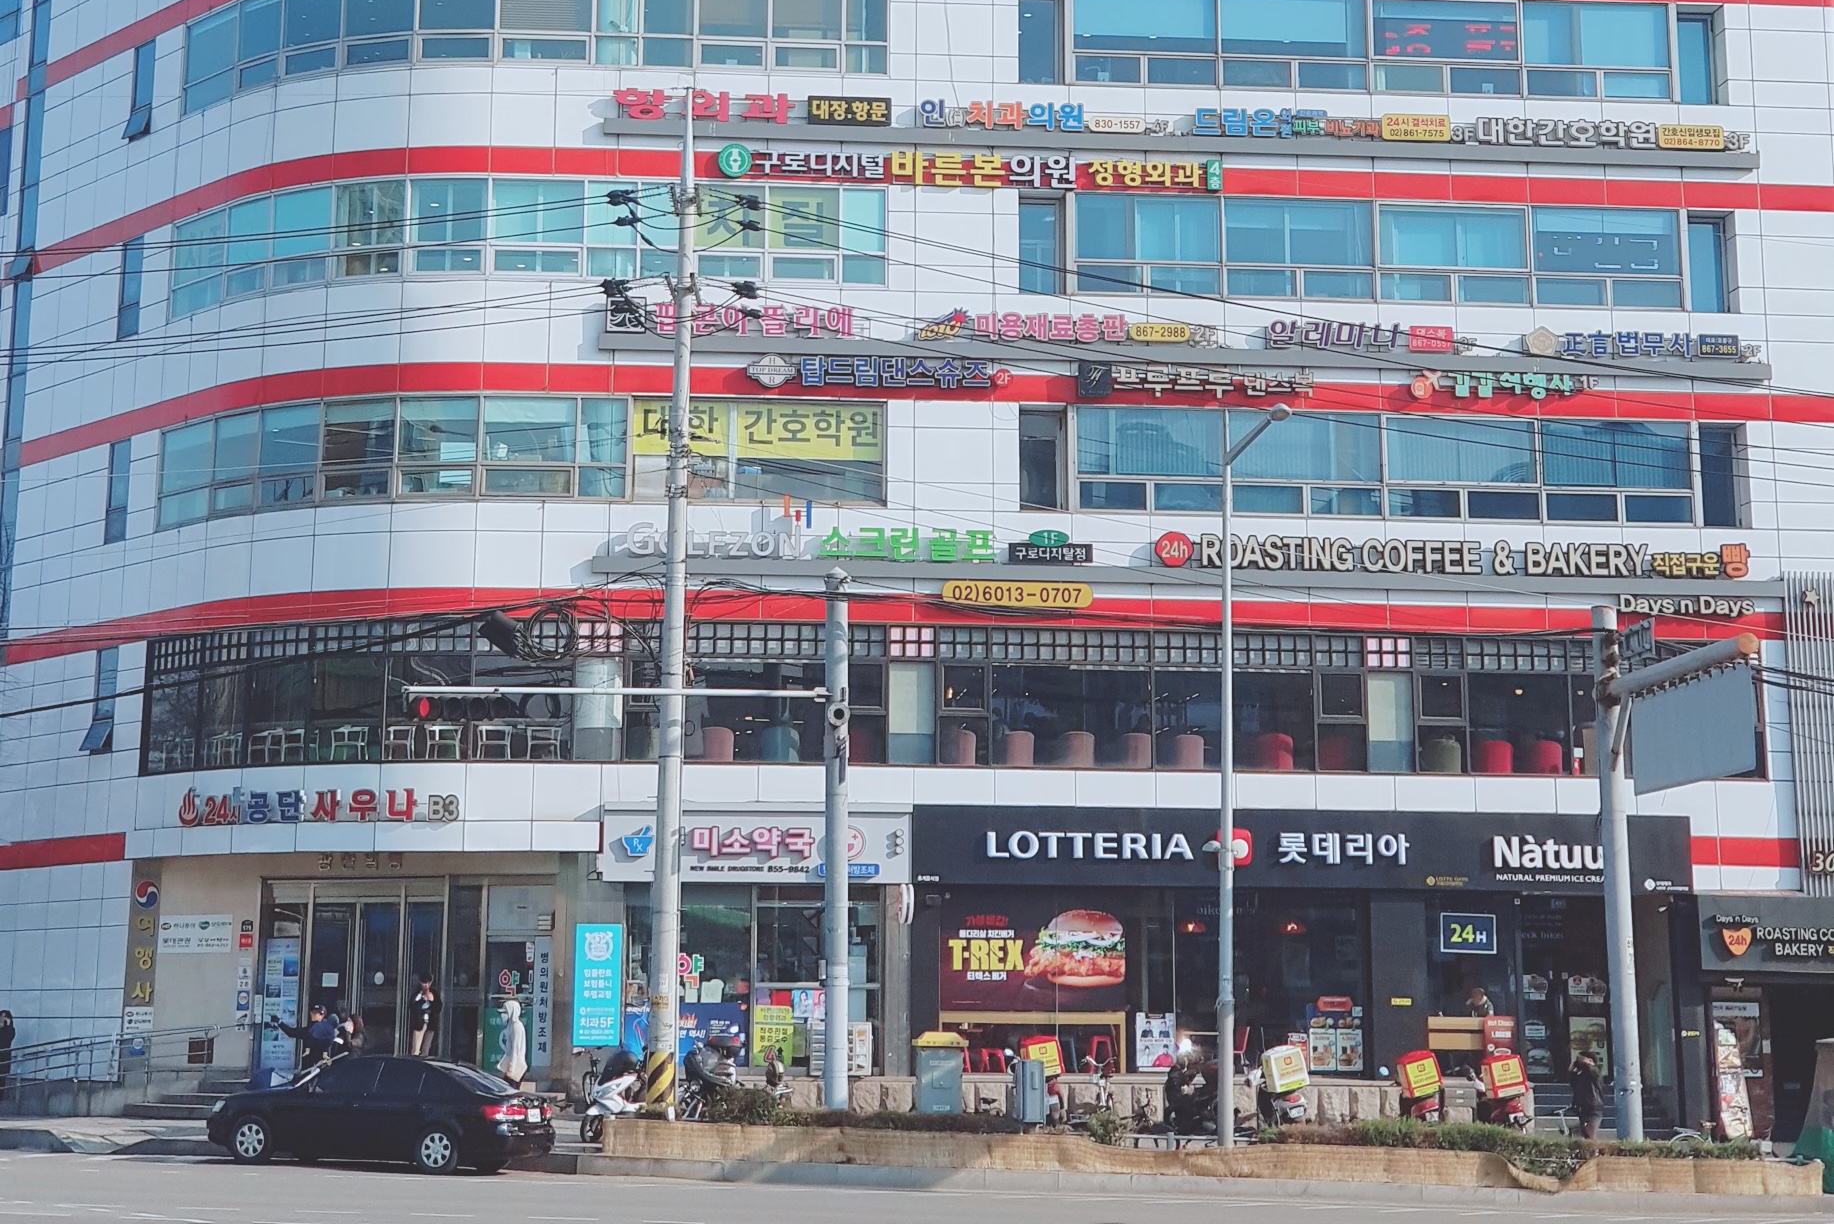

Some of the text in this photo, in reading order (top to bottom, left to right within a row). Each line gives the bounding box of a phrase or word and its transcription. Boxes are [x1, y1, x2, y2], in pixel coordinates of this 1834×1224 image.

[613, 87, 796, 124] 항외과
[1094, 119, 1141, 130] 830-1557
[1194, 108, 1277, 138] 드림온
[1390, 128, 1445, 138] 02)861-7575
[1476, 117, 1656, 149] 대한간호학원
[1663, 137, 1720, 147] 02)864-8770
[1088, 160, 1202, 189] 정형외과
[974, 311, 1127, 342] 미용재료총판
[1135, 325, 1186, 338] 867-2988
[801, 355, 991, 389] 탑드림댄스슈즈
[996, 371, 1011, 385] 2F
[744, 408, 879, 449] 간호학원
[819, 525, 996, 563] 스크린 골프
[1161, 539, 1188, 559] 24h
[1201, 533, 1355, 572] ROASTING
[1361, 538, 1483, 575] COFFEE
[1493, 539, 1516, 576] &
[1525, 541, 1649, 577] BAKERY
[1652, 552, 1720, 577] 직접구운
[952, 584, 1083, 604] 02)6013-0707
[1619, 594, 1755, 618] Days n Days
[203, 795, 241, 825] 24시
[427, 794, 460, 822] B3
[691, 826, 816, 859] 미소약국
[986, 829, 1410, 866] LOTTERIA 롯데리아
[1496, 874, 1535, 882] NATURAL
[1536, 874, 1571, 883] PREMIUM
[1571, 875, 1585, 883] ICE
[1450, 923, 1487, 944] 24H
[1716, 915, 1734, 924] Days
[1742, 915, 1759, 924] Days
[1728, 934, 1747, 946] 24h
[1757, 927, 1818, 941] ROASTING
[1774, 942, 1824, 956] BAKERY
[132, 916, 156, 1003] 여행사
[948, 939, 1025, 971] T-REX
[580, 1017, 615, 1028] 치과 5F
